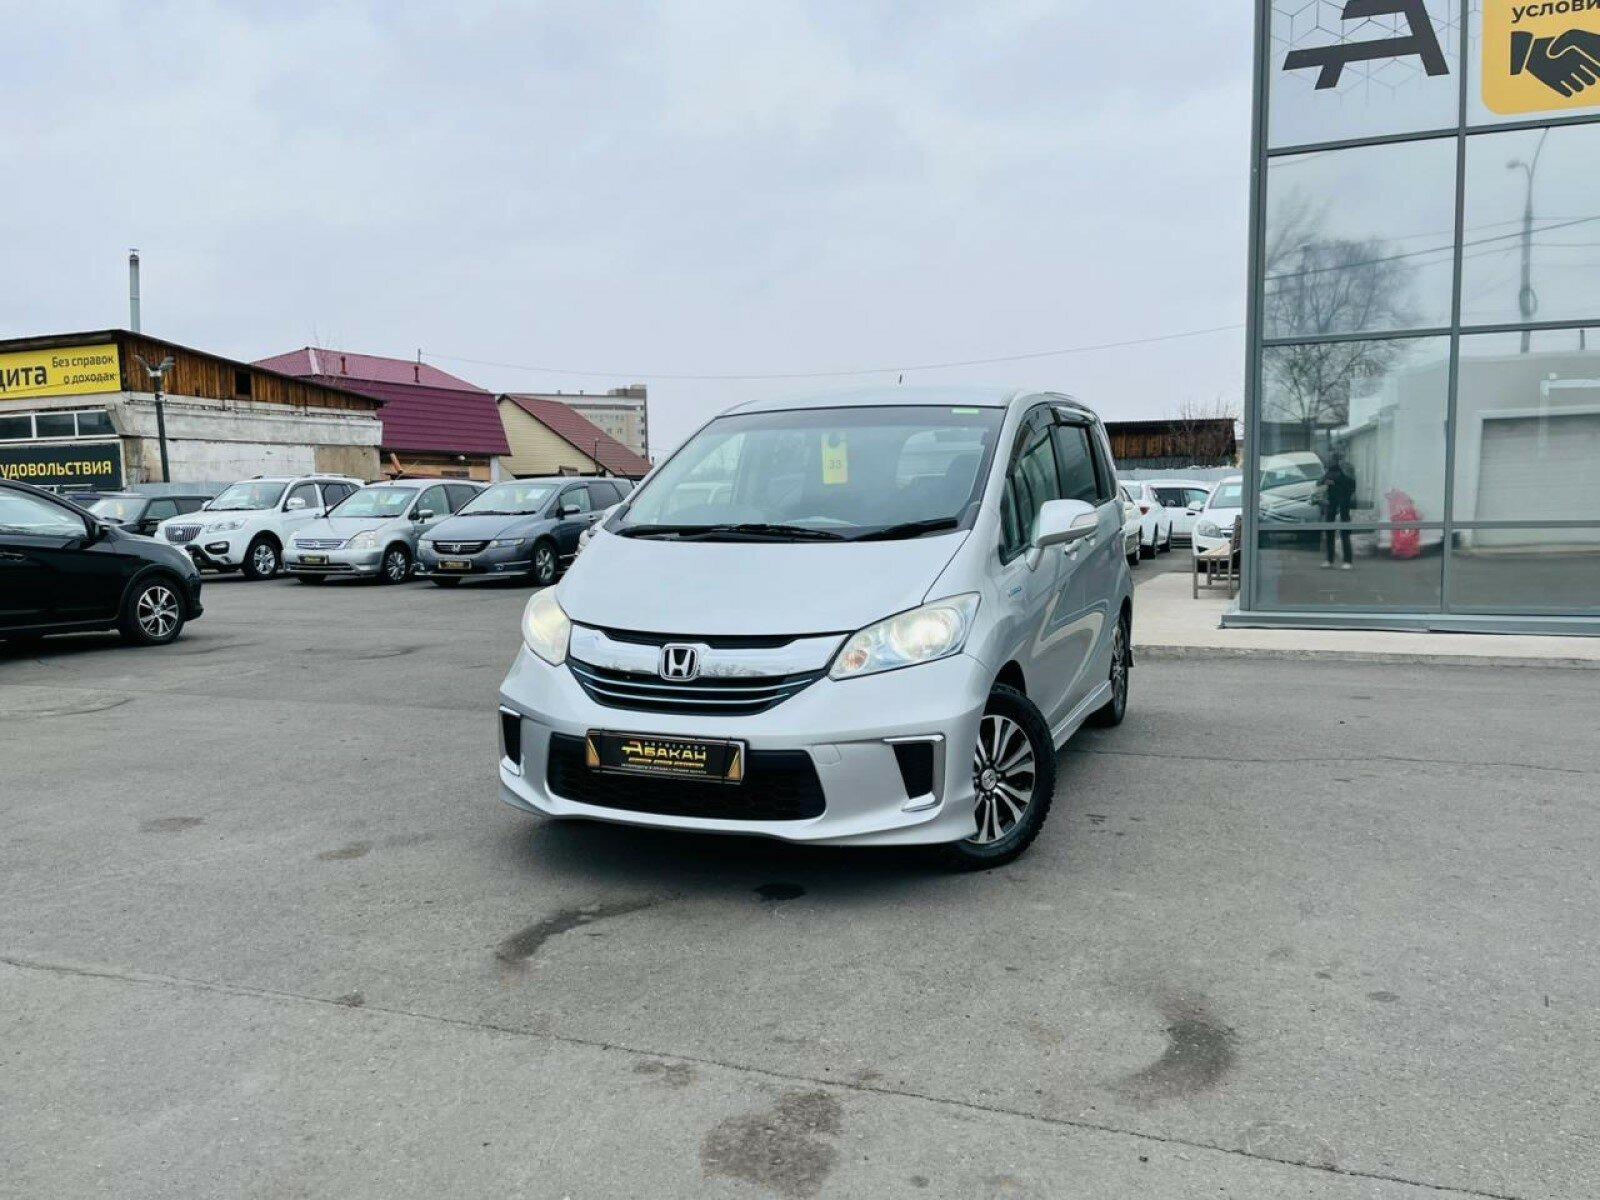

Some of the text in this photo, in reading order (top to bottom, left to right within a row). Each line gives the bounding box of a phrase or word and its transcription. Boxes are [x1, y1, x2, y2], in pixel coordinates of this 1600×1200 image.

[53, 356, 114, 368] Без справок
[63, 377, 70, 385] о
